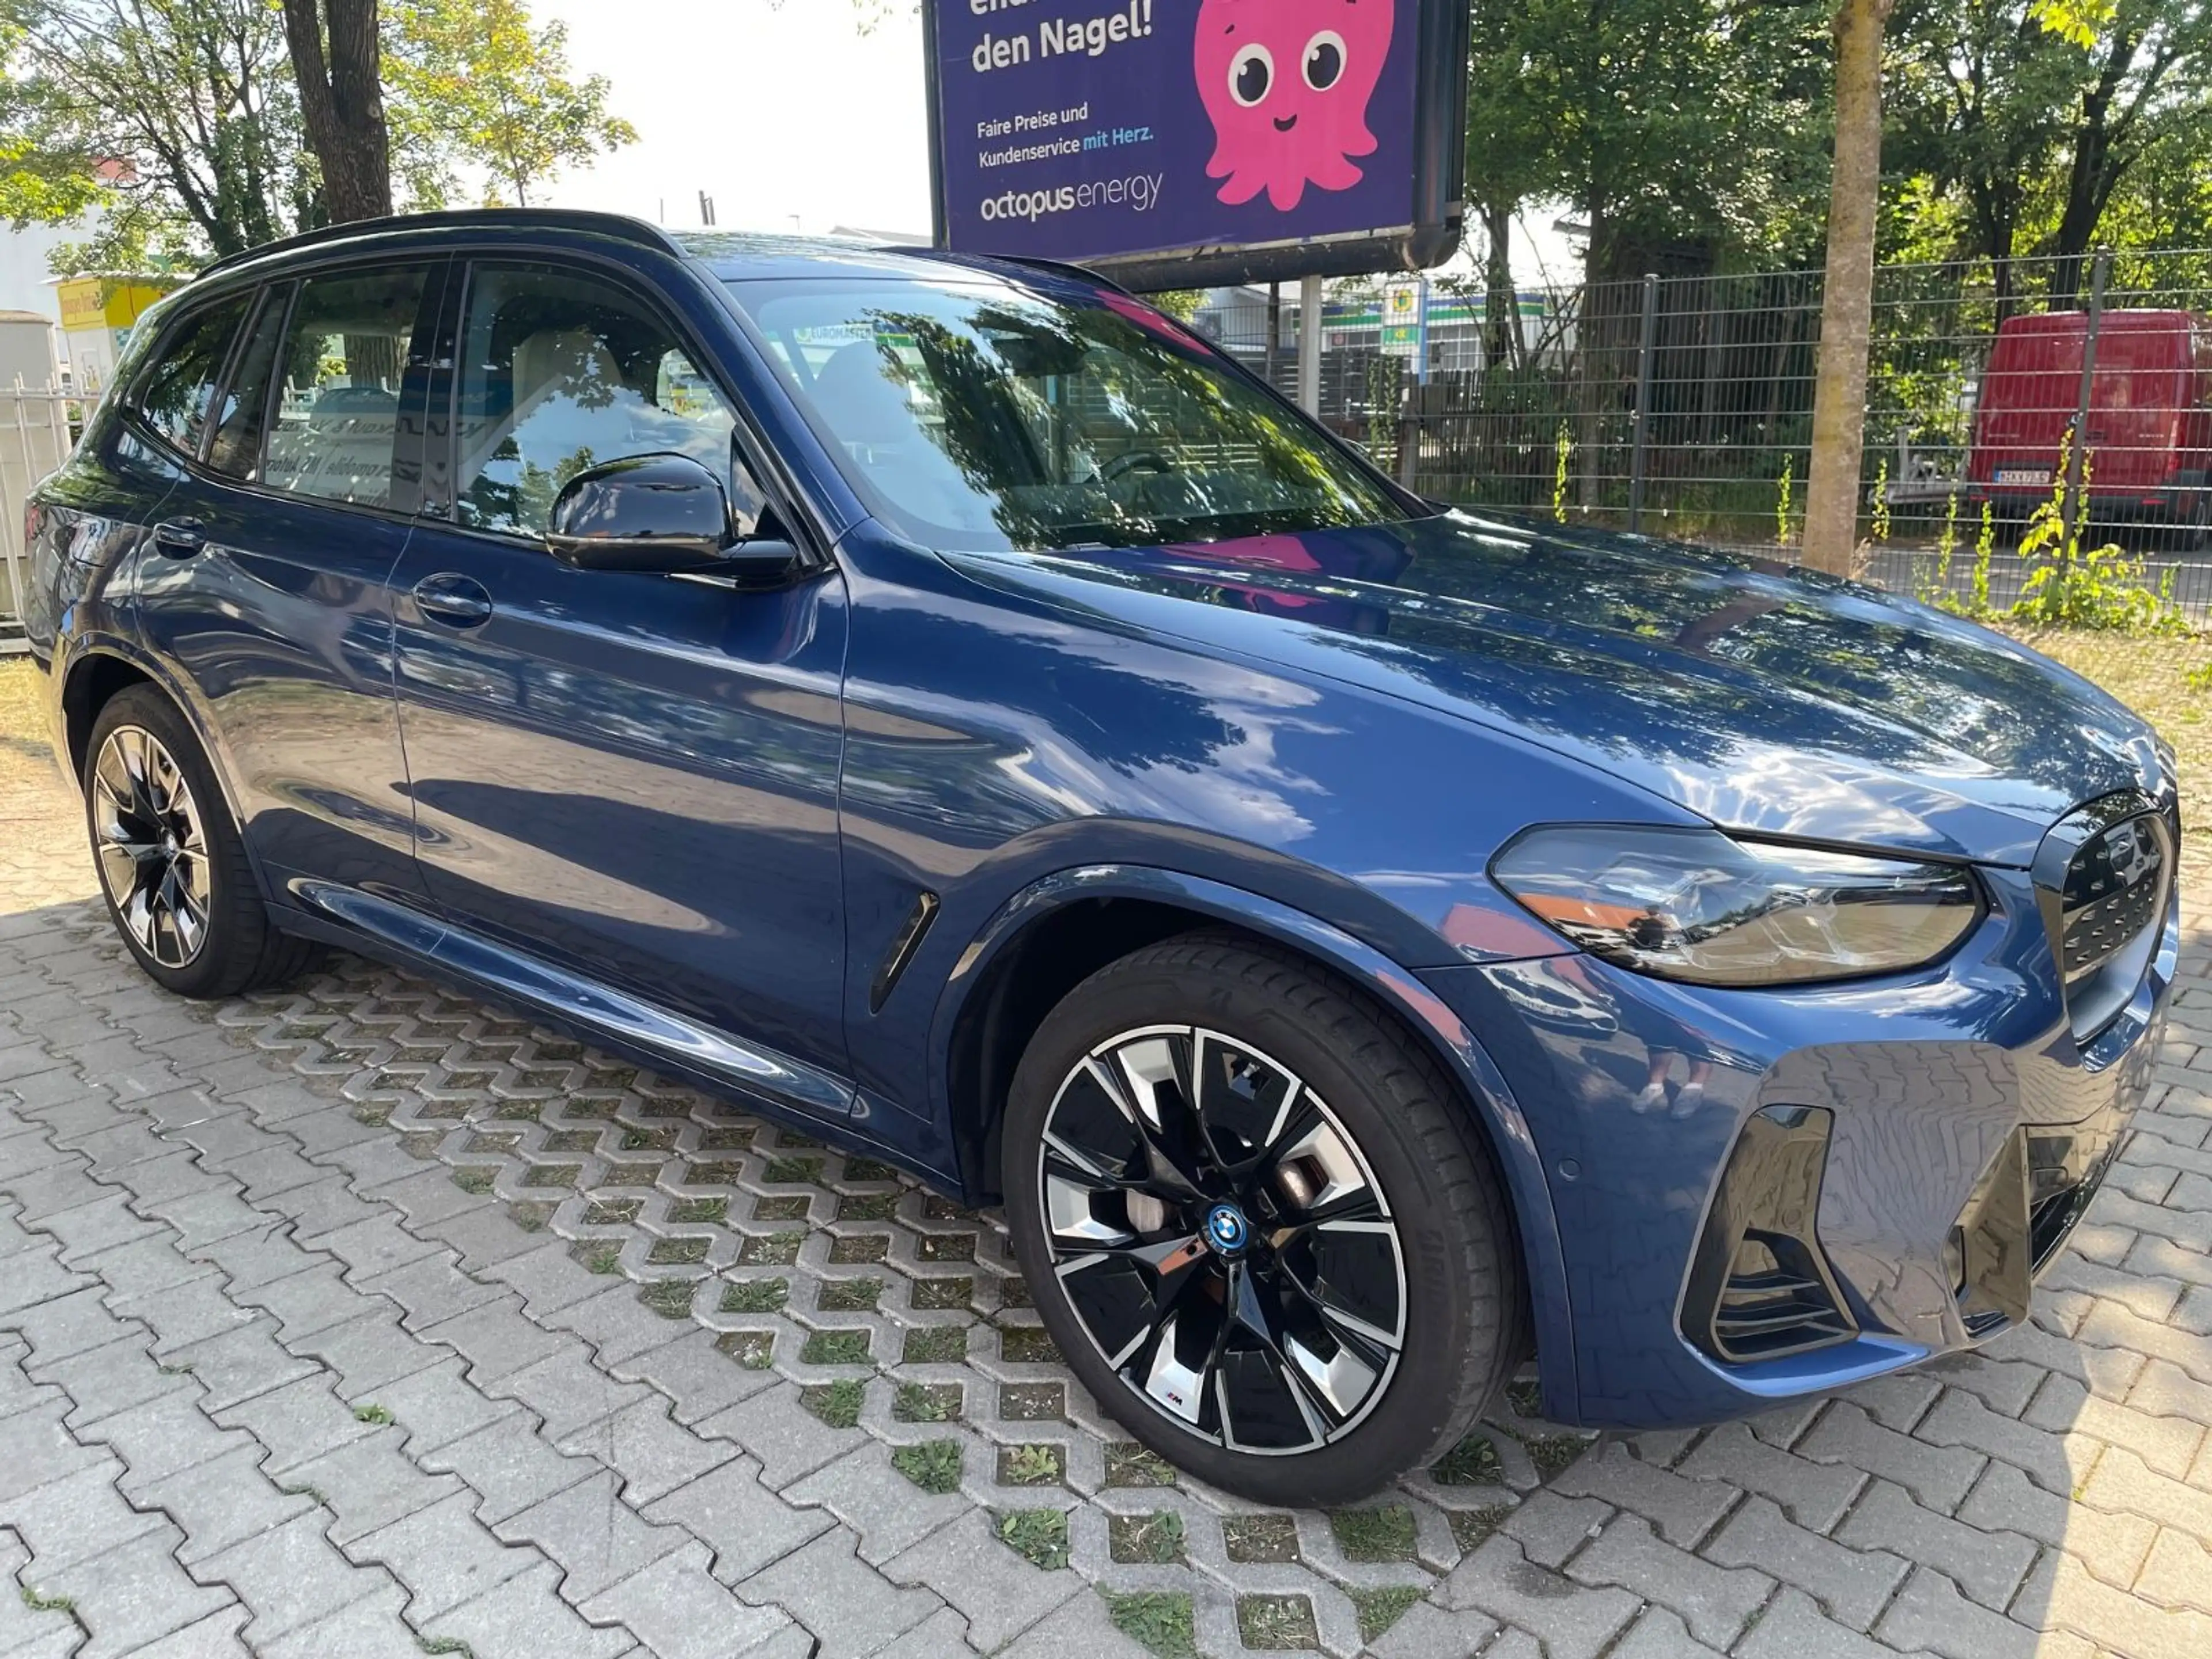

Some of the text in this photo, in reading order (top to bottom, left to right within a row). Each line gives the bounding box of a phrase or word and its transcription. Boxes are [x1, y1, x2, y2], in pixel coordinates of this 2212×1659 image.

[972, 0, 1152, 73] den Nagel!
[977, 101, 1088, 139] Faire Preise und
[979, 126, 1154, 168] Kundenservice mit Herz.
